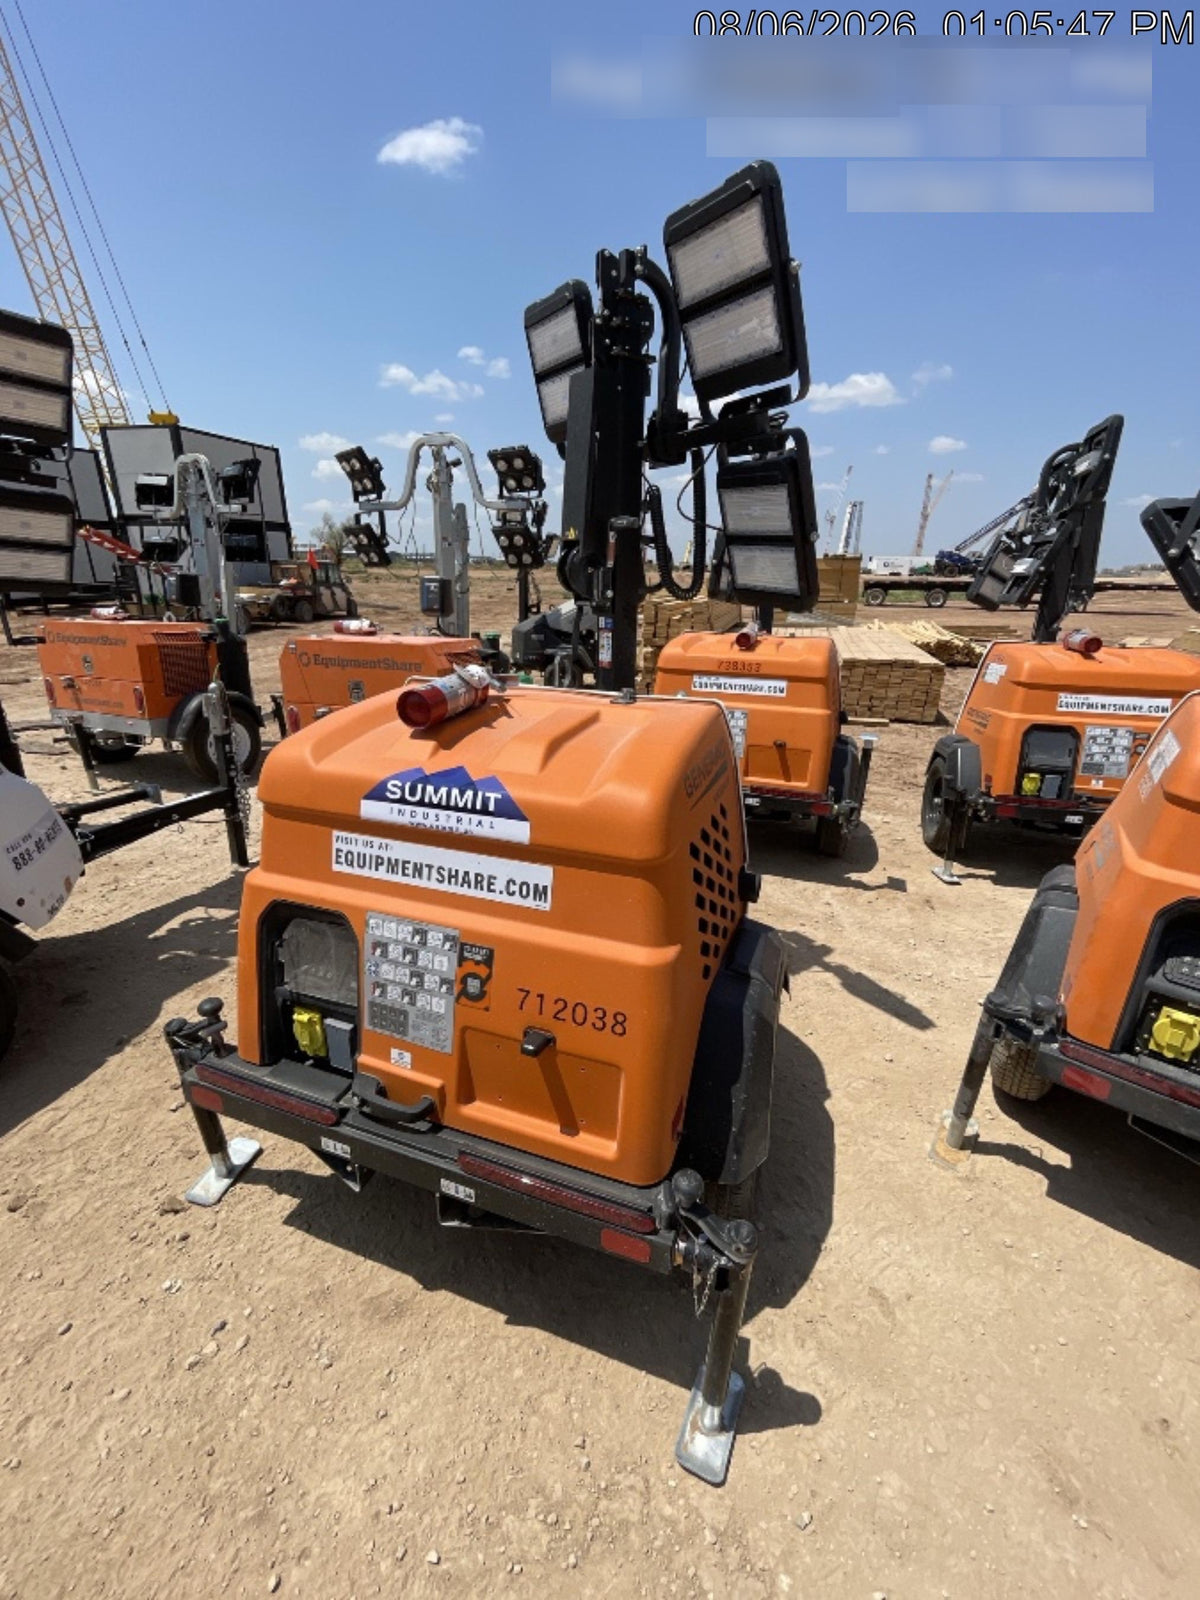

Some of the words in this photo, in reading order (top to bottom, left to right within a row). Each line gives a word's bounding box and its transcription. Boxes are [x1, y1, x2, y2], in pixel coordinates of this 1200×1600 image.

[313, 653, 422, 672] EquipmentShare
[385, 780, 502, 812] SUMMIT
[390, 806, 495, 830] INDUSTRIAL
[335, 835, 359, 847] VISIT
[362, 839, 374, 849] US
[335, 848, 549, 904] EQUIPMENTSHARE.COM
[517, 987, 628, 1037] 712038
